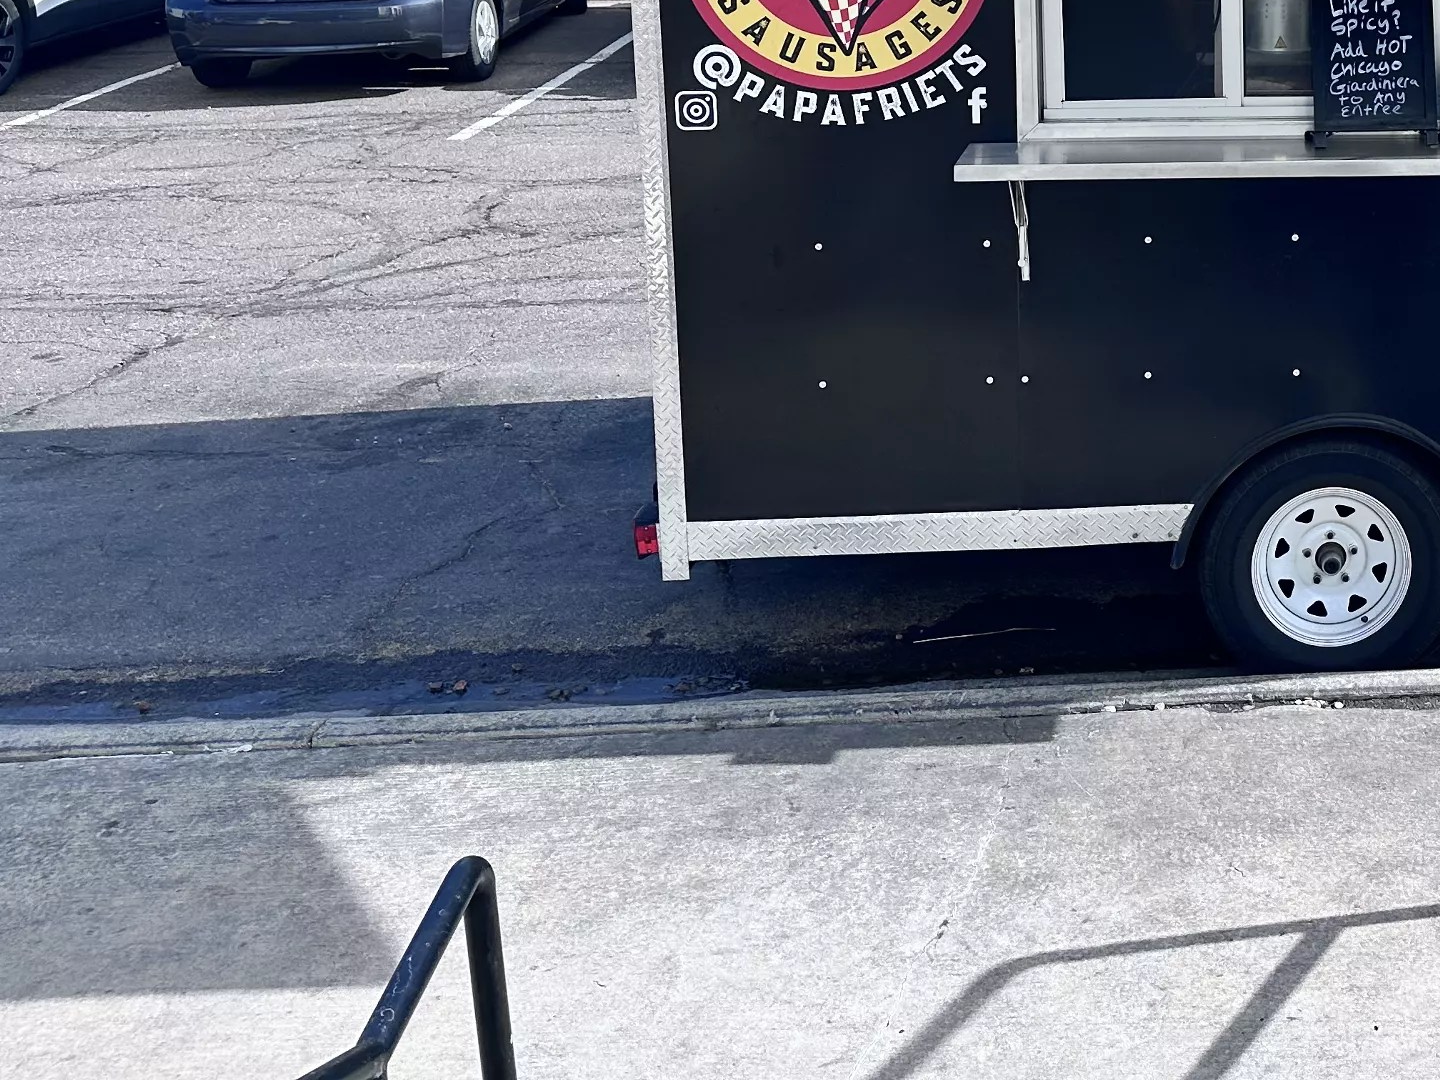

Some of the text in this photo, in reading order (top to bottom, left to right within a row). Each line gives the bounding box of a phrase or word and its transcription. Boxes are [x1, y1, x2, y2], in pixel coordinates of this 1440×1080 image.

[1330, 9, 1401, 38] Spicy?
[1330, 35, 1413, 61] Add HOT
[1330, 60, 1403, 80] Chicago
[692, 42, 987, 126] @PAPAFRIETS
[1329, 76, 1420, 95] Giardiniera
[1339, 91, 1406, 106] to Any
